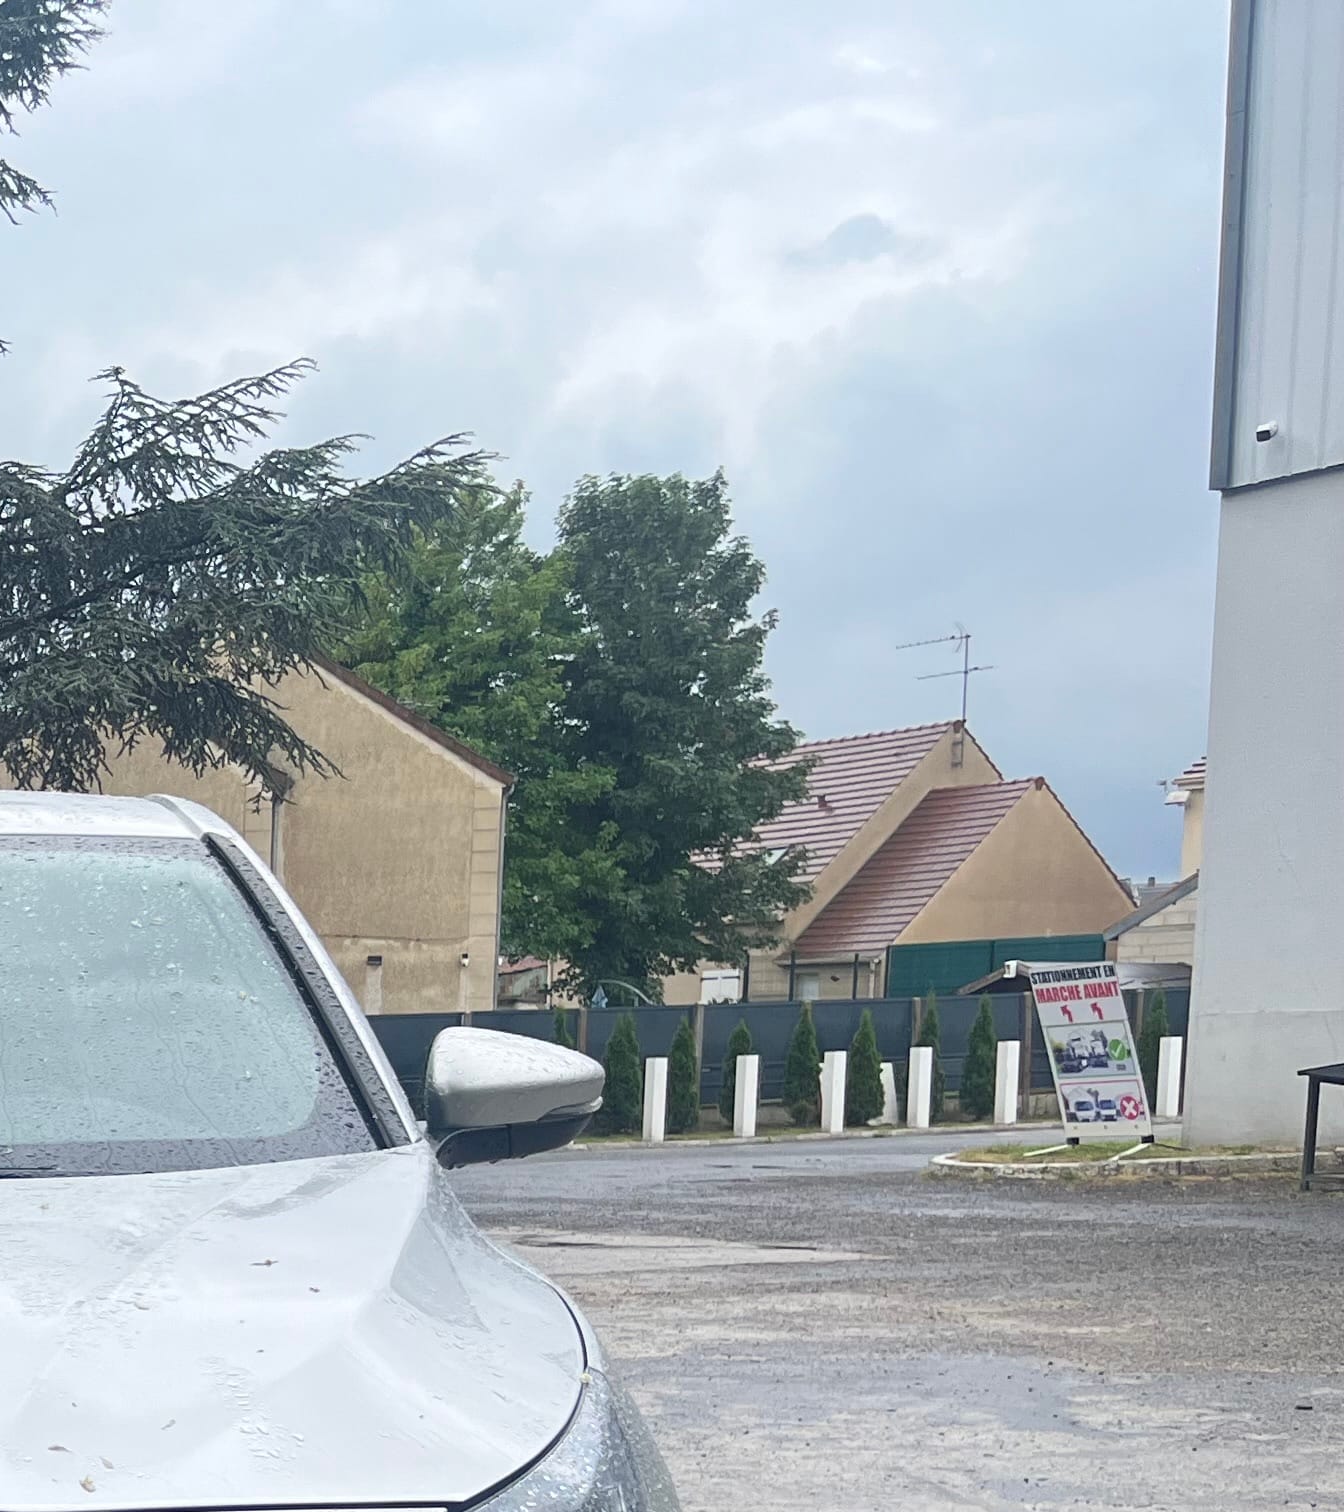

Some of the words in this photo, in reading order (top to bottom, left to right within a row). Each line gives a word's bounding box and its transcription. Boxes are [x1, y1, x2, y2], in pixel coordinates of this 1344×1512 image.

[1032, 966, 1102, 984] STATIONNEMENT
[1103, 965, 1116, 977] EN
[1035, 985, 1082, 1003] MARCHE
[1084, 981, 1119, 999] AVANT
